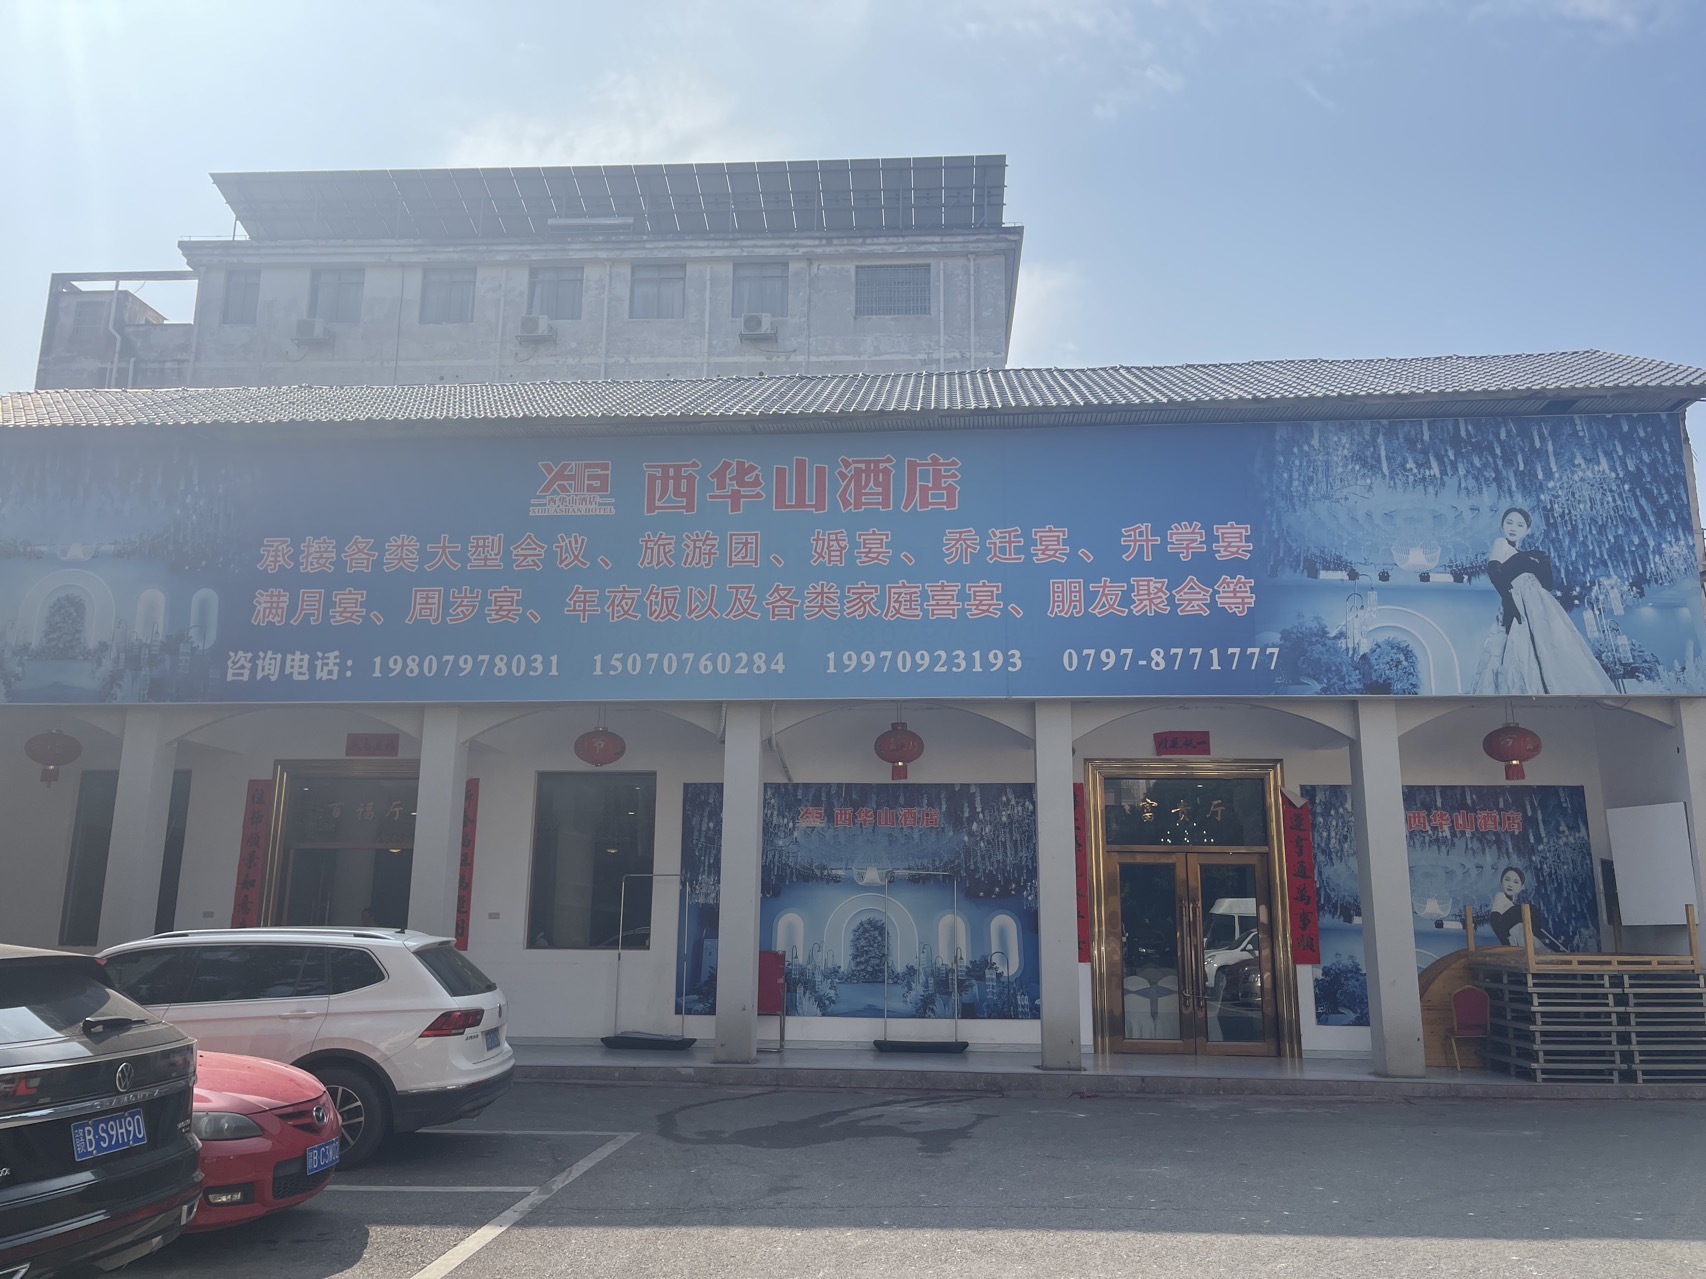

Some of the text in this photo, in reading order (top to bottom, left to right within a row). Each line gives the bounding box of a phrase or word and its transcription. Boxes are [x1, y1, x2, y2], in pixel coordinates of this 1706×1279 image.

[643, 453, 962, 516] 西华山酒店
[371, 652, 559, 678] 19807978031
[592, 650, 785, 677] 15070760284
[825, 648, 1023, 674] 19970923193
[1062, 646, 1281, 672] 0797-8771777
[328, 801, 404, 821] 百福厅
[834, 807, 940, 828] 西华山酒店
[1406, 809, 1523, 832] 西华山酒店
